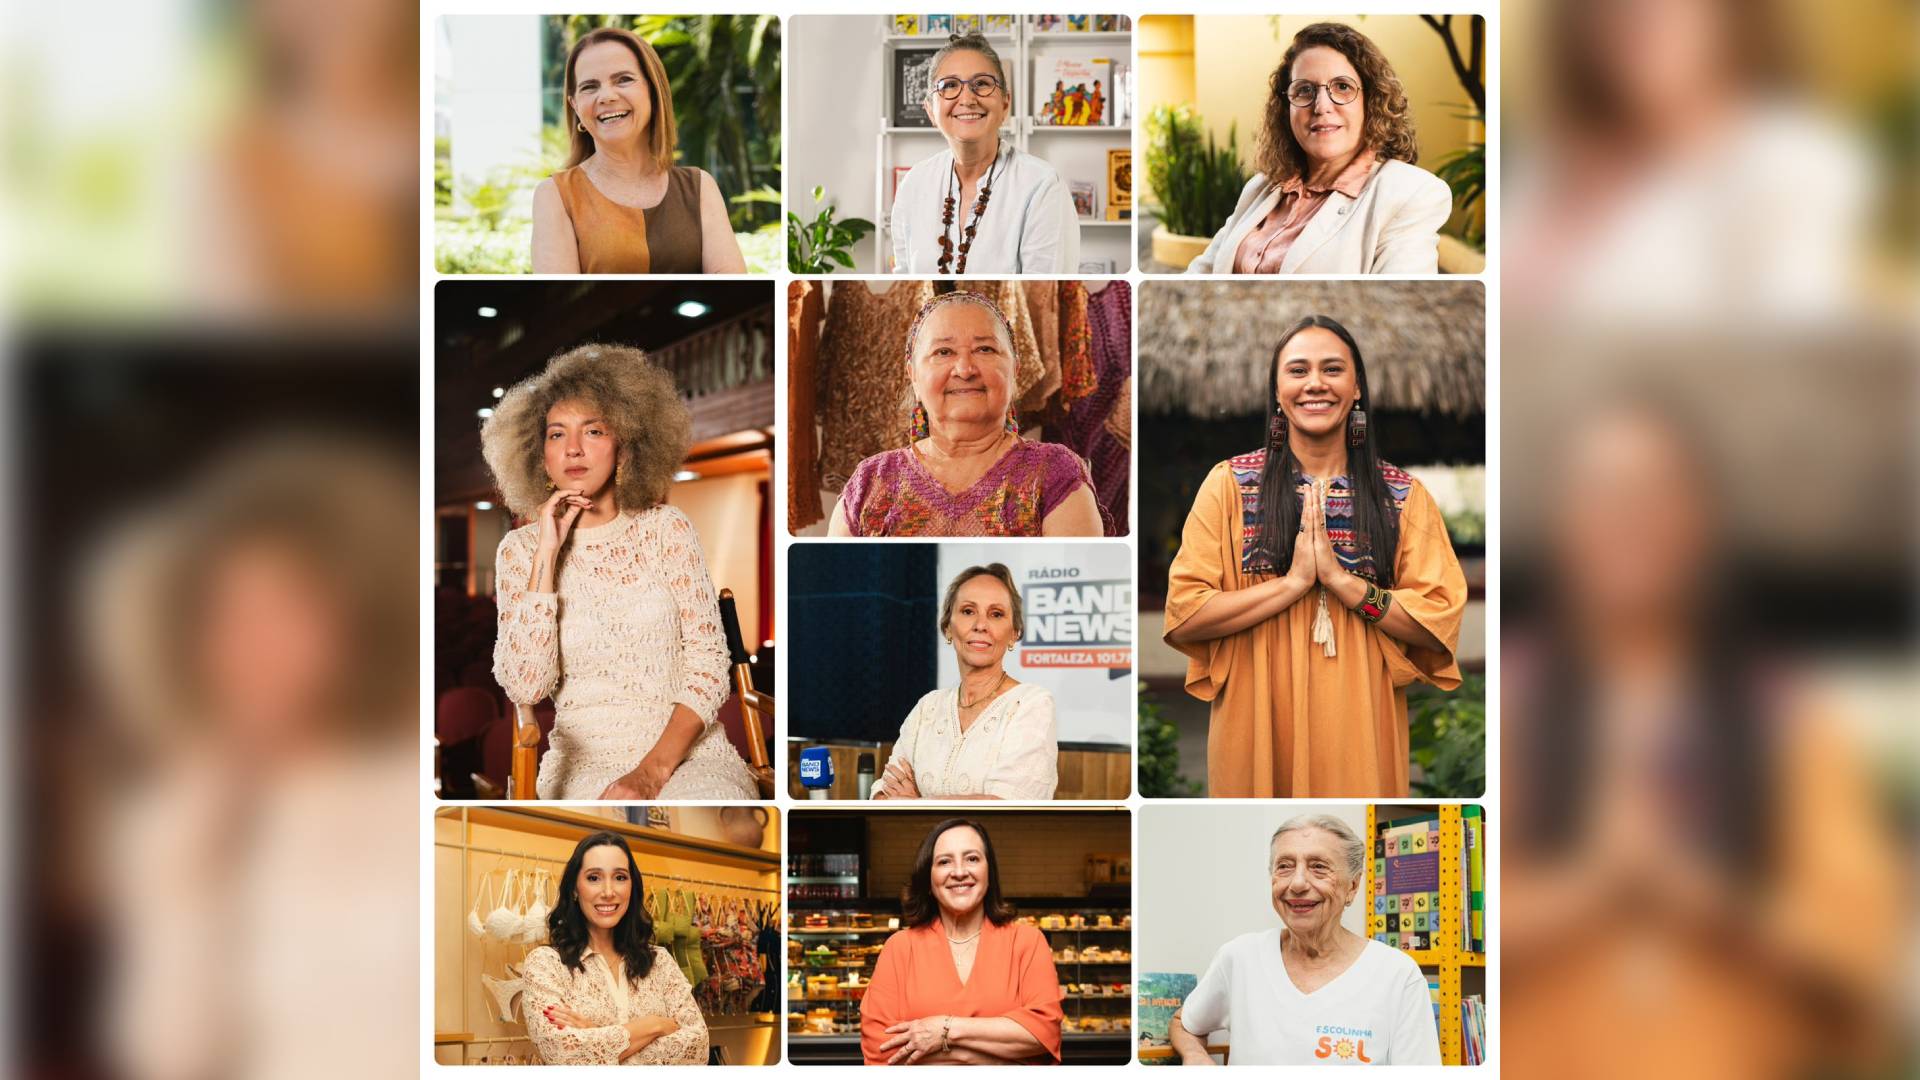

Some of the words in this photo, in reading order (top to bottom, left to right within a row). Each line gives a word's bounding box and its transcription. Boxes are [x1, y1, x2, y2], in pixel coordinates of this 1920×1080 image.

[1028, 567, 1080, 579] RÁDIO
[1026, 584, 1131, 615] BAND
[1025, 612, 1131, 642] NEWS
[1026, 652, 1094, 665] FORTALEZA
[1315, 1025, 1373, 1038] ESCOLINHA
[1314, 1036, 1373, 1063] SOL
